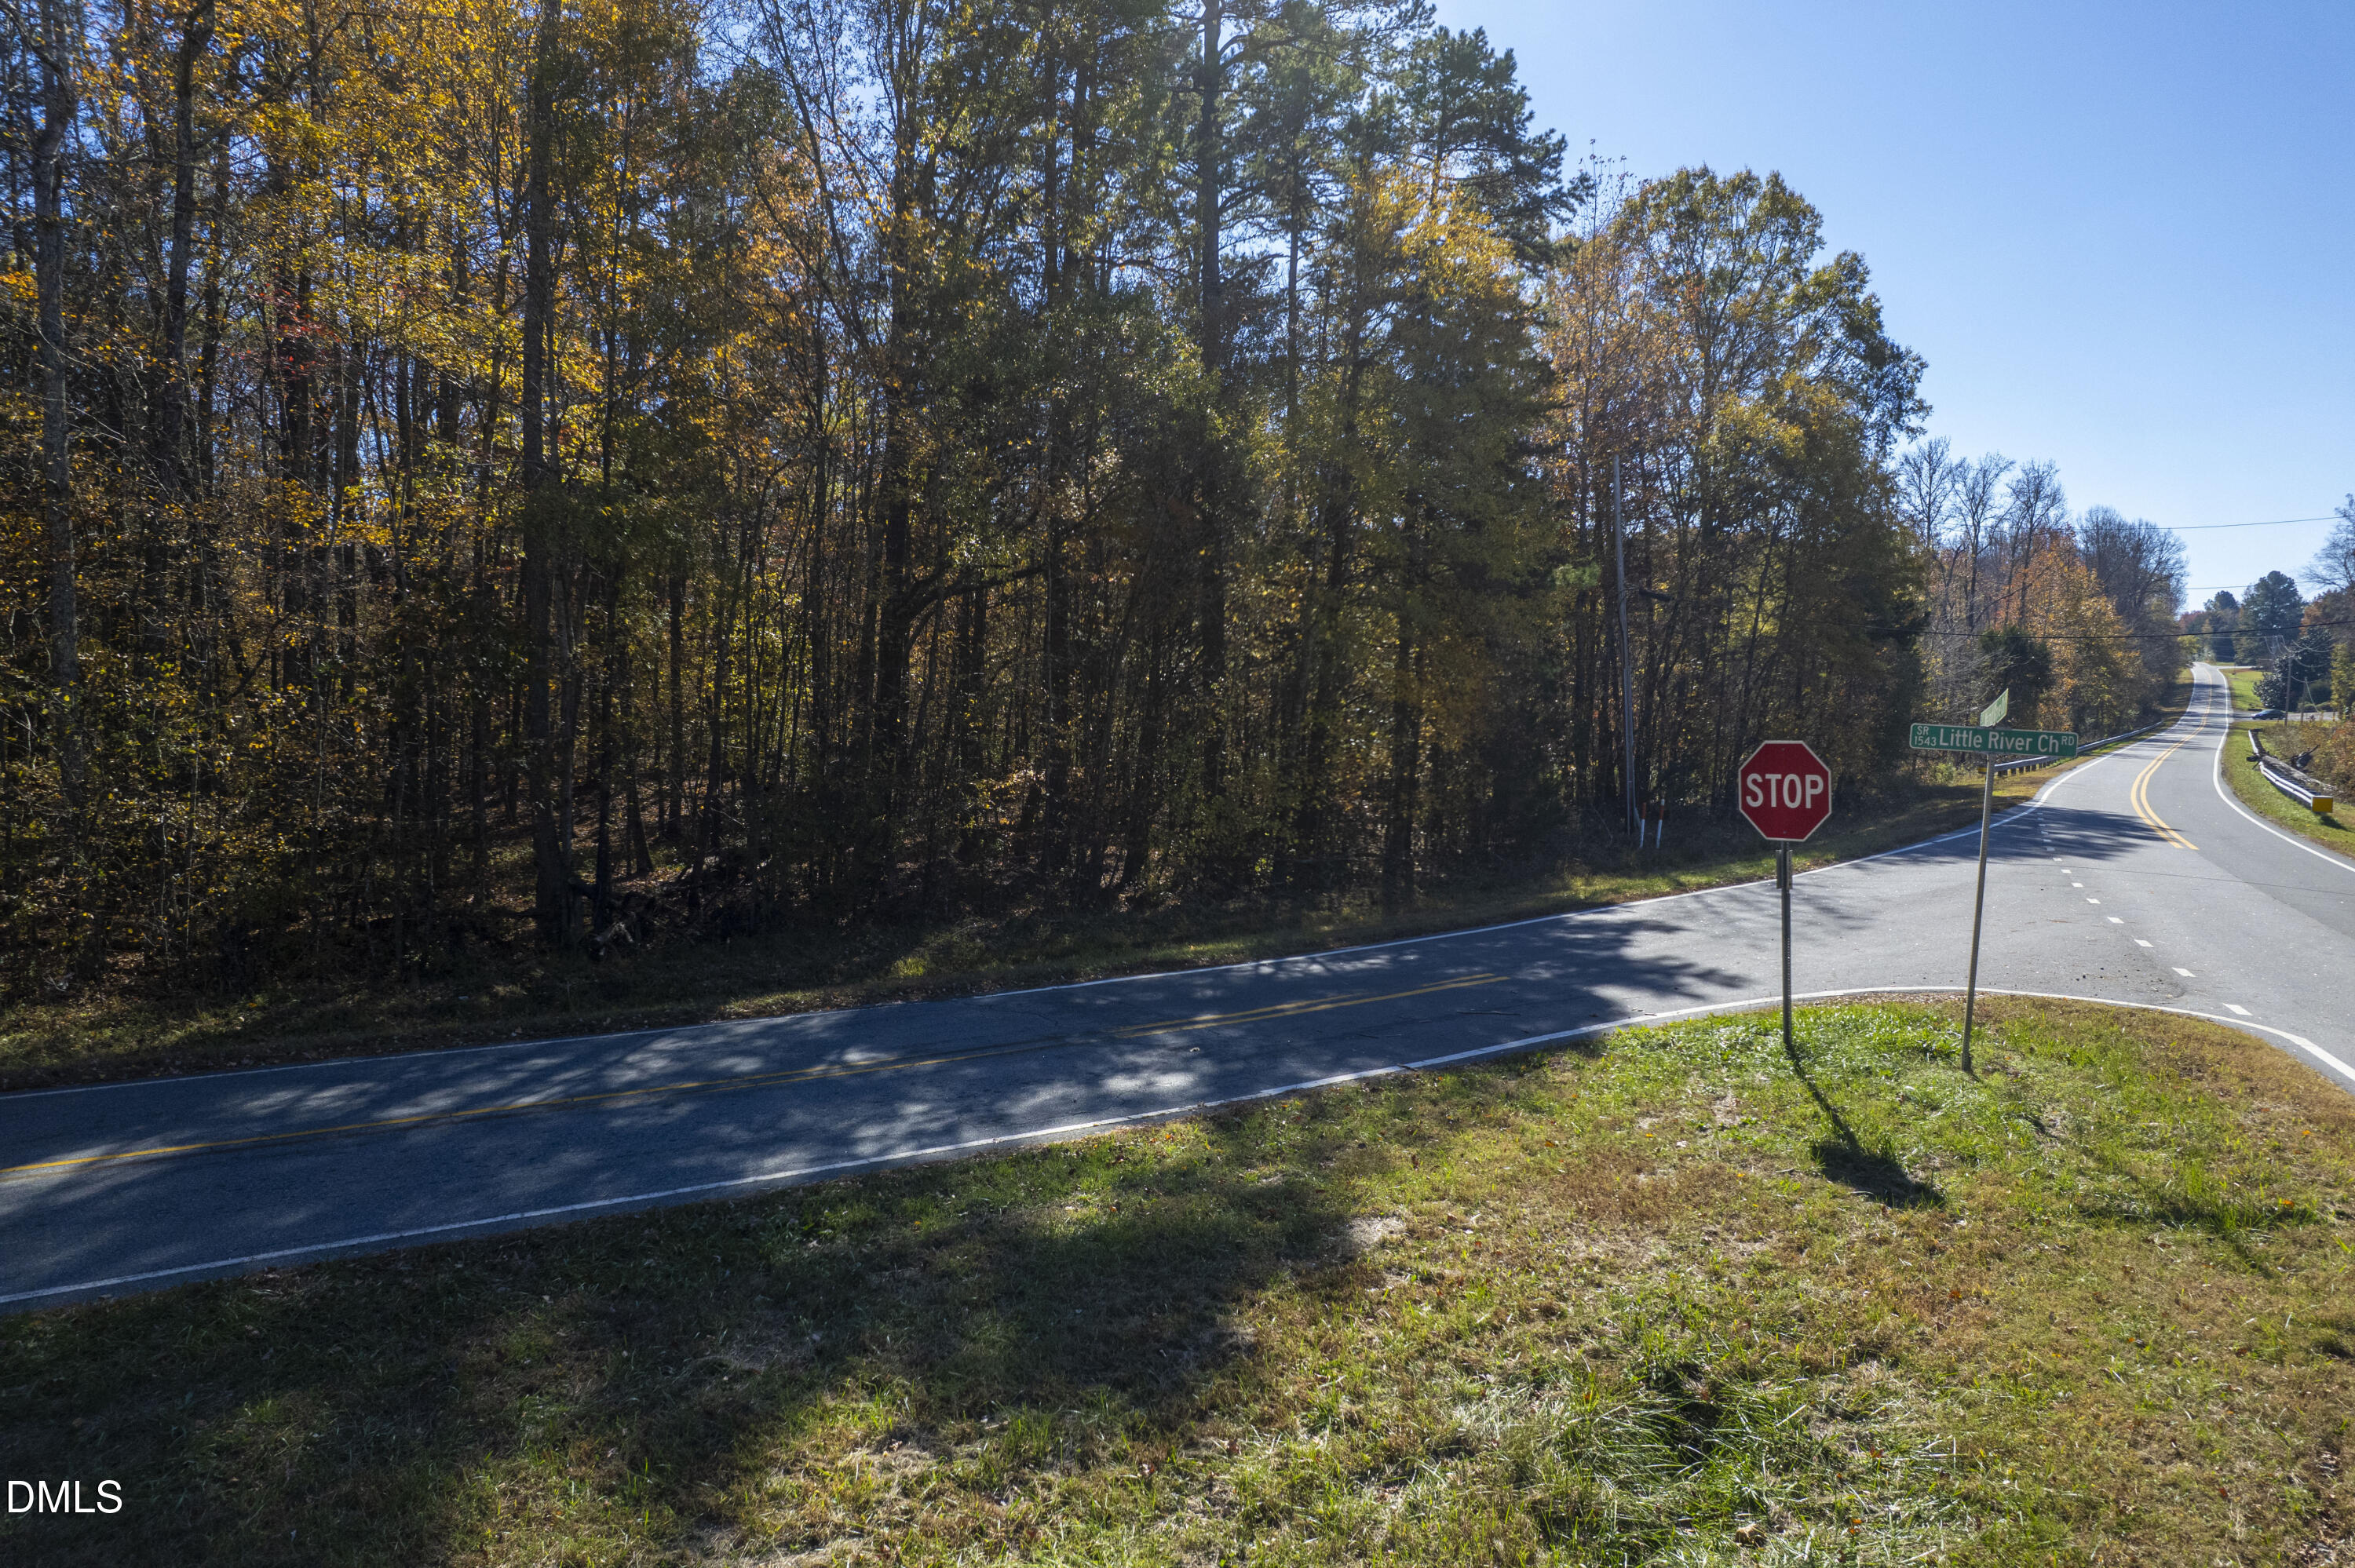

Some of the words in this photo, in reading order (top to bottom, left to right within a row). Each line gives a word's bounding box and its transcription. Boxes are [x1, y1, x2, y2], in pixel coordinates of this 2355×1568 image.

[1917, 726, 1929, 735] SR
[1914, 736, 1937, 746] 1543
[1939, 728, 1983, 748] Little
[1988, 731, 2033, 751] River
[2037, 734, 2059, 753] Ch
[2061, 736, 2075, 746] RD
[1746, 773, 1824, 808] STOP
